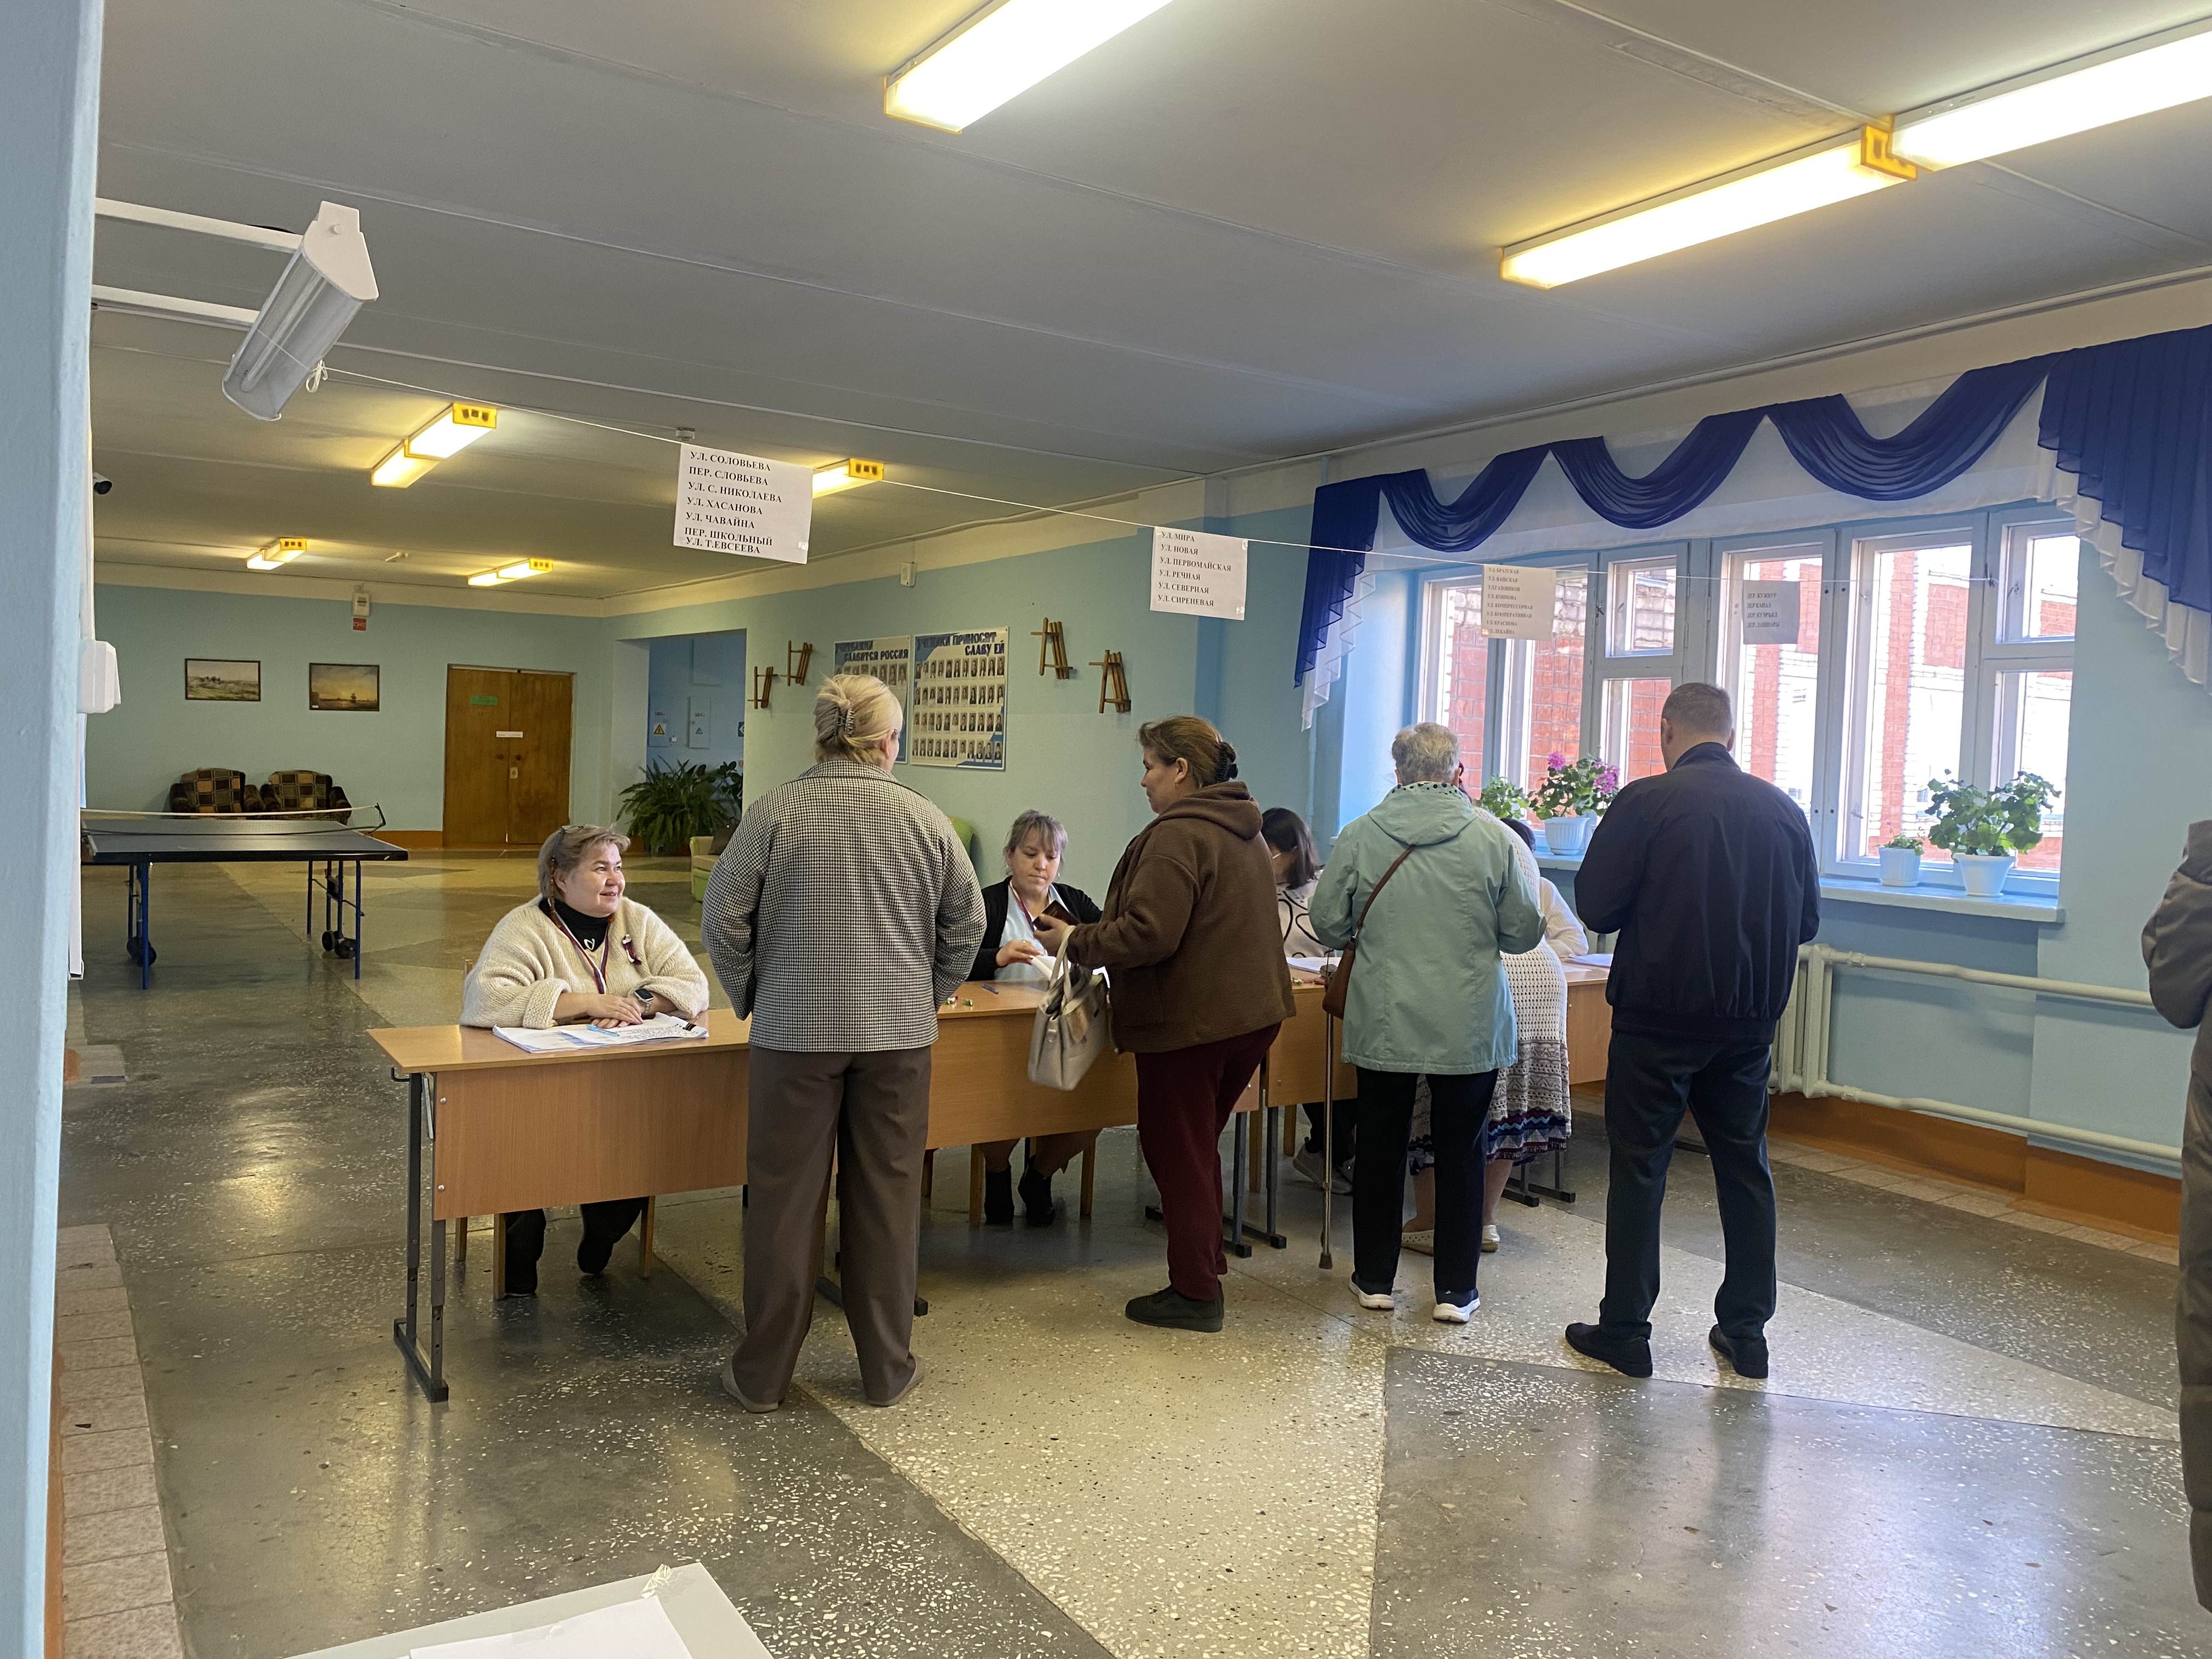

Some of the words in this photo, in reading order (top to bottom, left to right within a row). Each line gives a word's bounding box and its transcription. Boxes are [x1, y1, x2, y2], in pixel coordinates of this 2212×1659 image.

[690, 452, 707, 461] УЛ.
[710, 454, 771, 471] СОЛОВЬЕВА
[689, 466, 712, 477] ПЕР.
[715, 470, 768, 486] СЛОВЬЕВА
[688, 482, 705, 491] УЛ.
[708, 484, 717, 493] С.
[720, 487, 782, 503] НИКОЛАЕВА
[687, 497, 703, 506] УЛ.
[707, 499, 763, 515] ХАСАНОВА
[686, 512, 702, 521] УЛ.
[706, 515, 755, 528] ЧАВАЙНА
[685, 527, 707, 537] ПЕР.
[710, 531, 772, 545] ШКОЛЬНЫЙ
[1175, 533, 1195, 542] МИРА
[686, 537, 702, 546] УЛ.
[706, 539, 760, 554] Т.ЕВСЕЕВА
[1174, 546, 1198, 555] НОВАЯ
[1173, 558, 1231, 572] ПЕРВОМАЙСКАЯ
[1172, 571, 1200, 580] РЕЧНАЯ
[1172, 584, 1209, 594] СЕВЕРНАЯ
[1171, 596, 1214, 606] СИРЕНЕВАЯ
[952, 632, 997, 645] ПРИНОСЯТ
[844, 651, 878, 662] СЛАВИТСЯ
[881, 649, 909, 660] РОССИЯ
[965, 644, 992, 657] СЛАВУ
[994, 640, 1005, 654] ЕЙ
